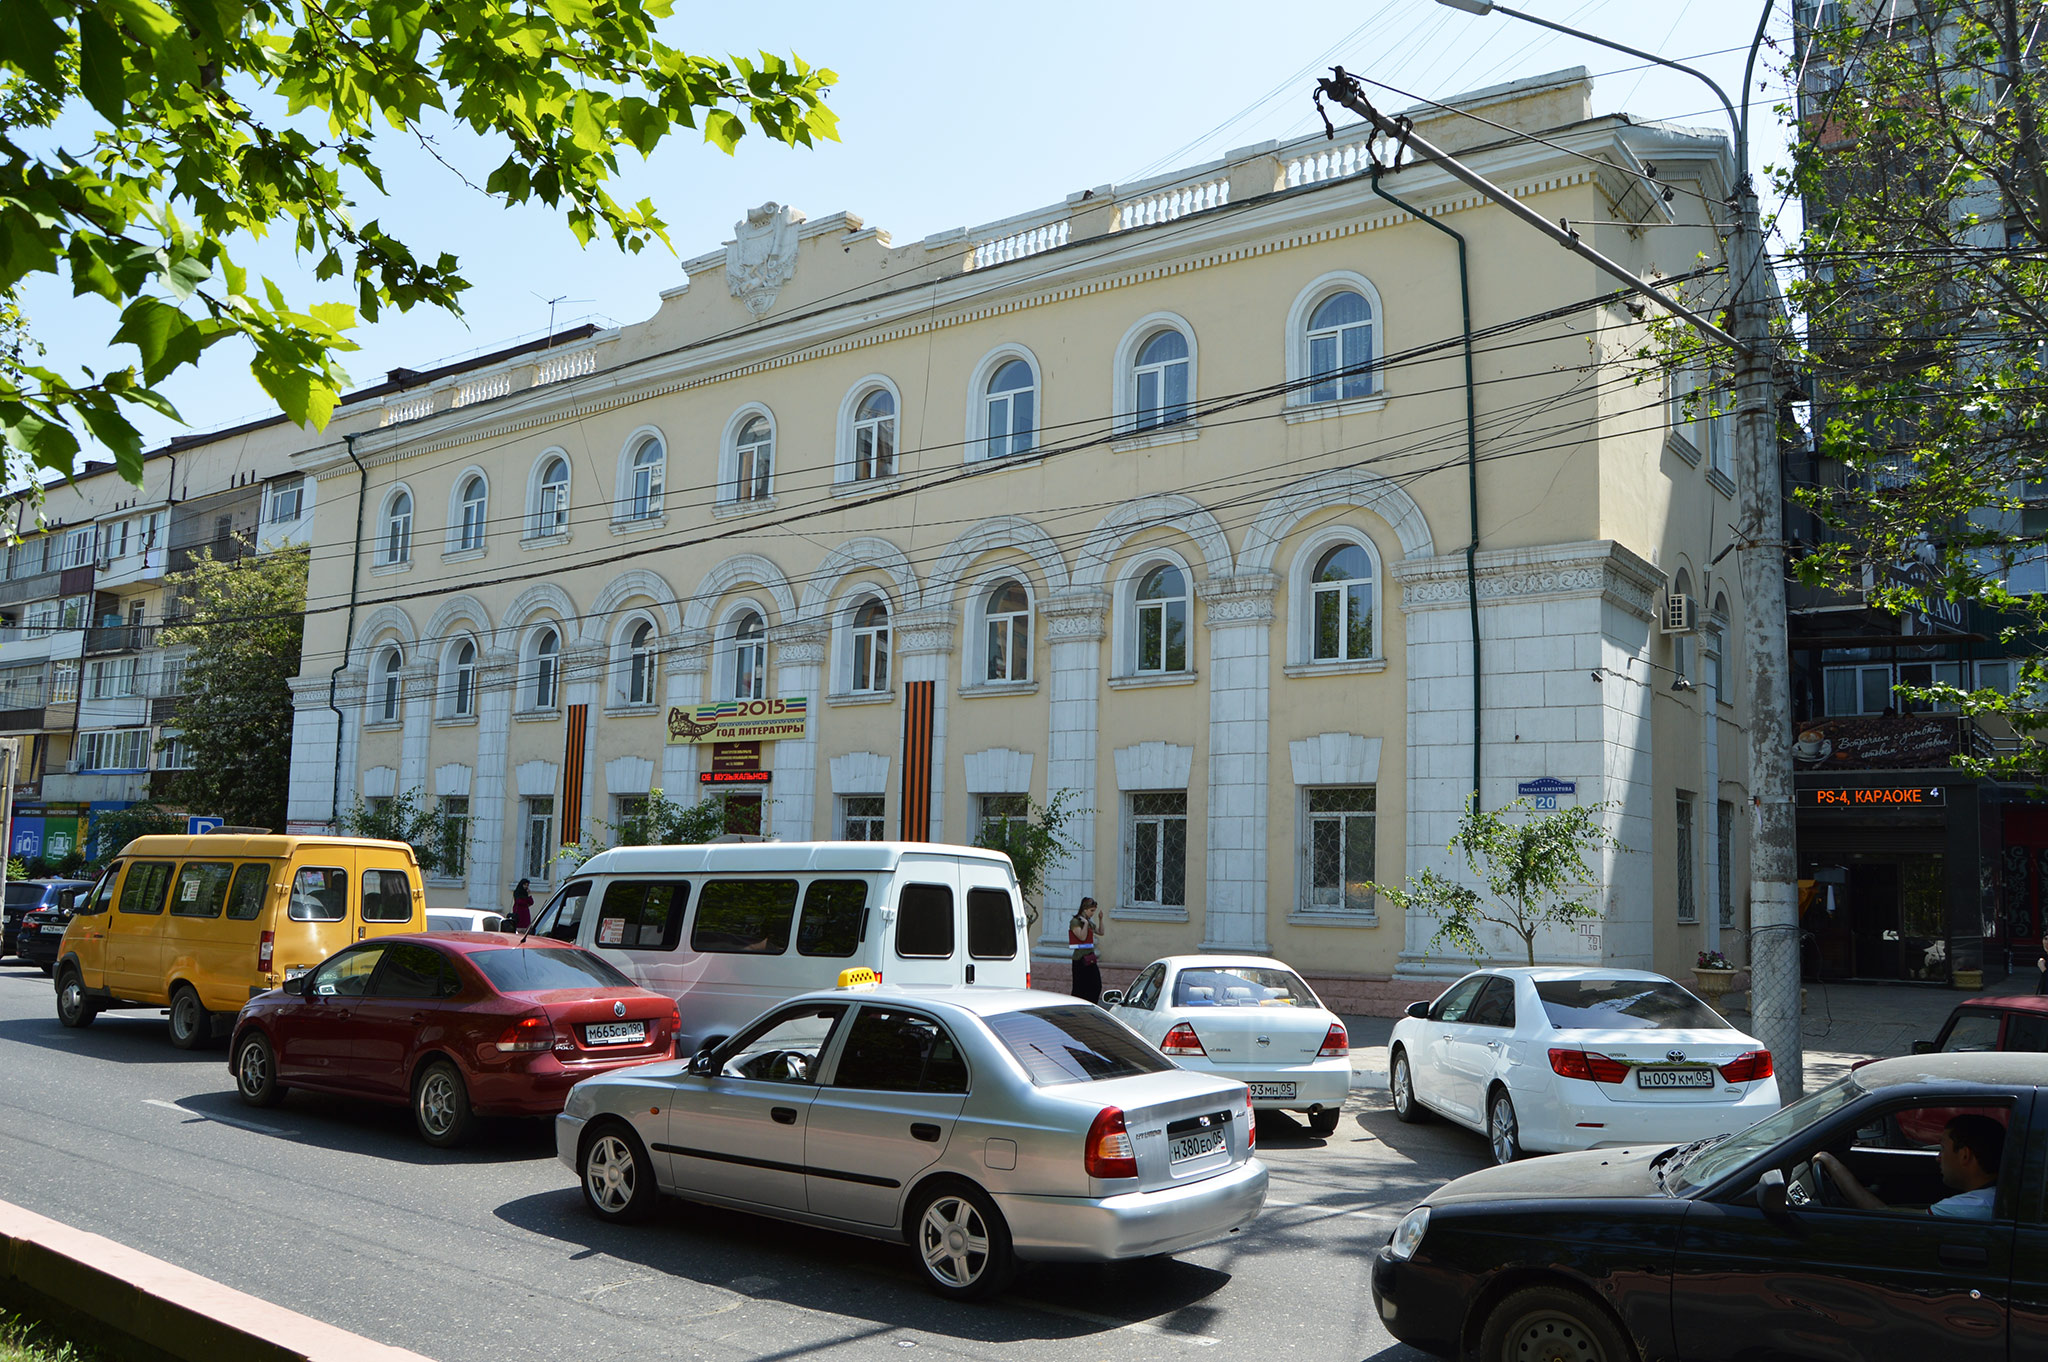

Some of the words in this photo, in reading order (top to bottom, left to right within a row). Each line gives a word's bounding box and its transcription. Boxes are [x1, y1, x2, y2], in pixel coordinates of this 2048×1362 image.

[738, 699, 786, 717] 2015
[716, 728, 736, 738] ГОД
[738, 724, 805, 737] ЛИТЕРАТУРЫ
[1537, 797, 1555, 809] 20
[1817, 790, 1851, 806] PS-4,
[1855, 789, 1922, 803] КАРАОКЕ
[1581, 924, 1595, 934] ПГ
[628, 1023, 643, 1034] 190
[1696, 1071, 1709, 1082] 05
[1281, 1083, 1292, 1093] 05
[1212, 1131, 1224, 1144] 05
